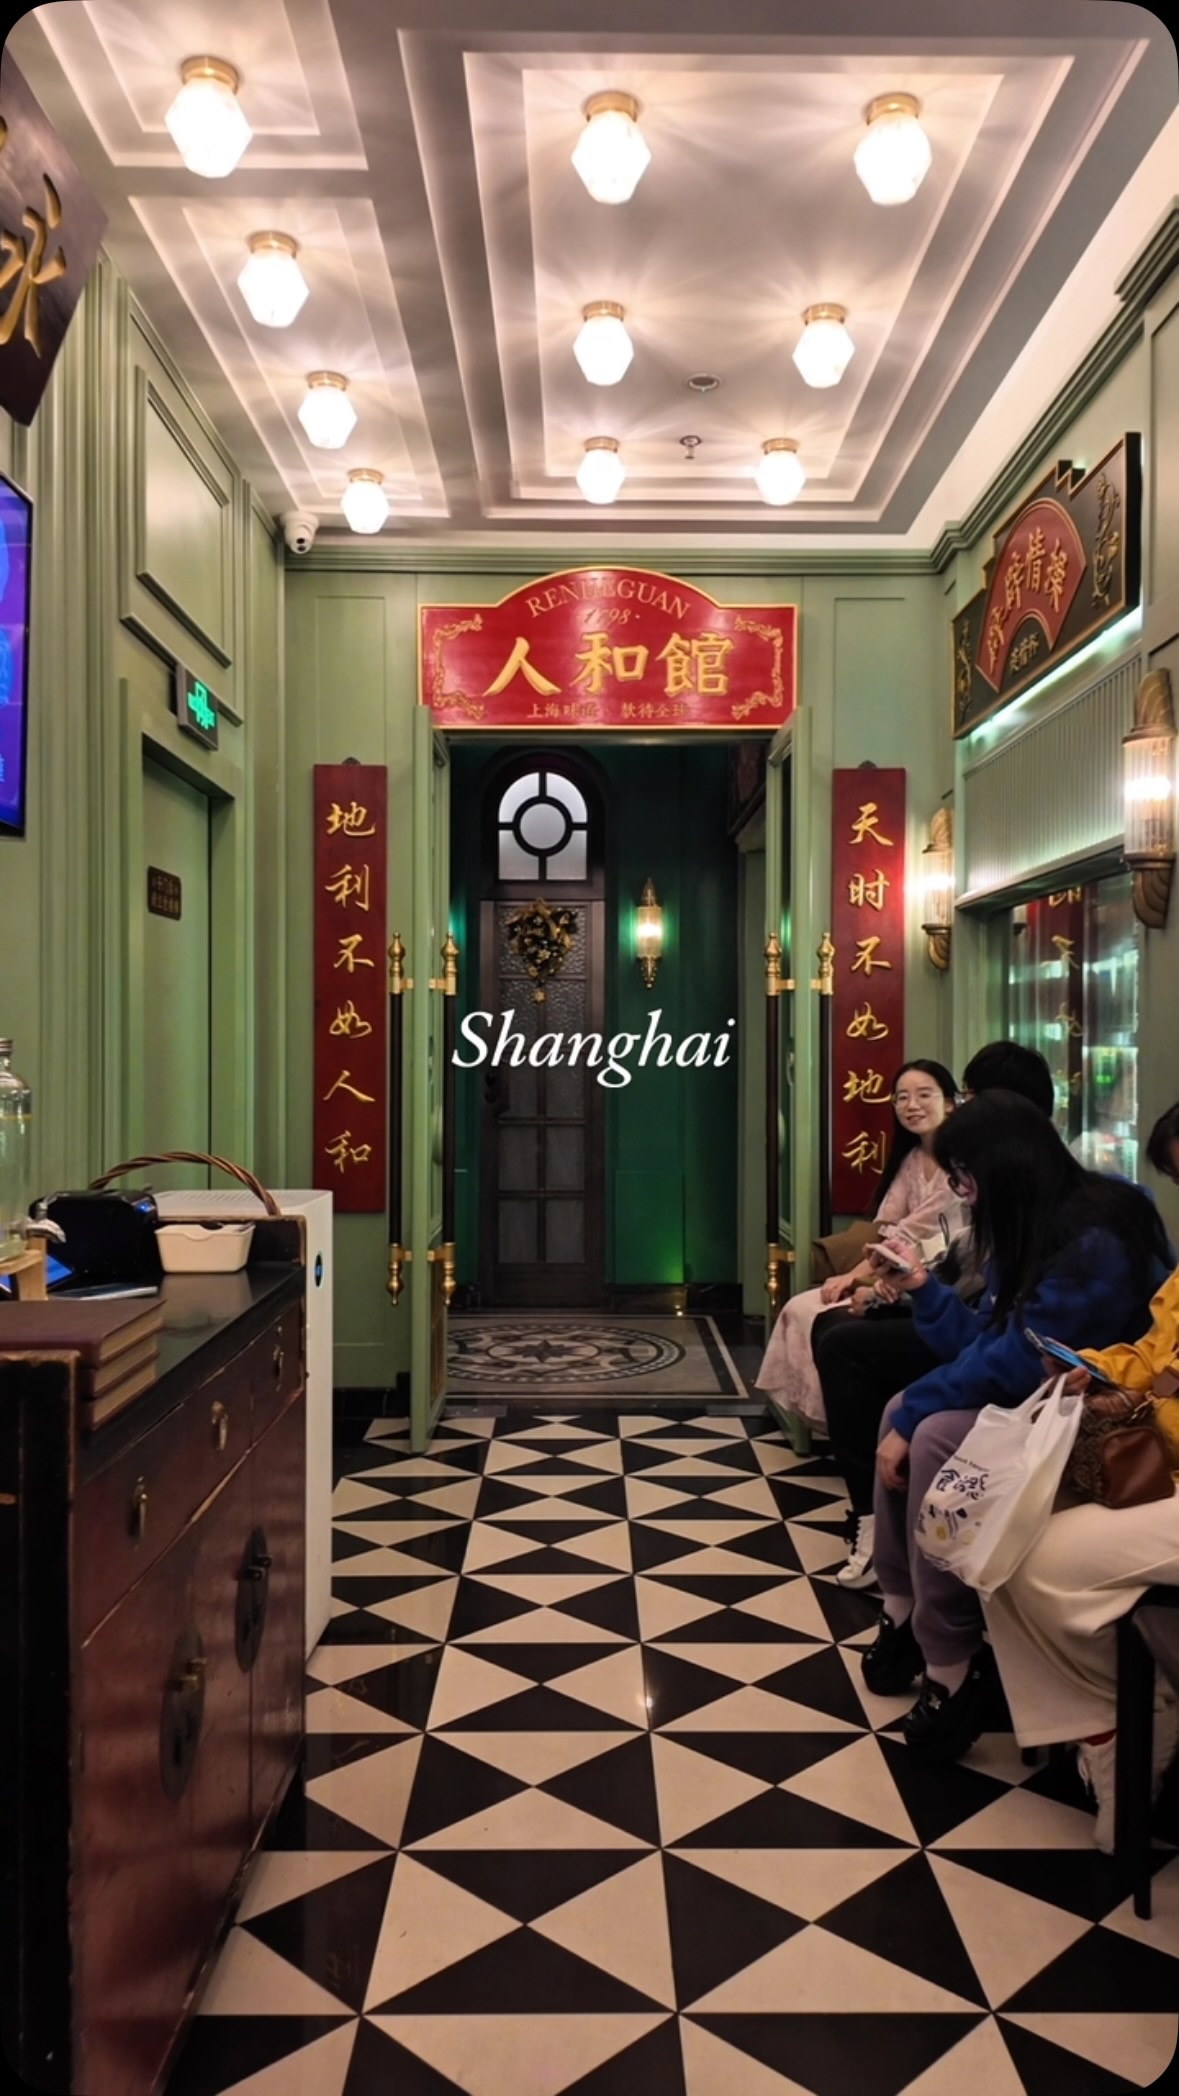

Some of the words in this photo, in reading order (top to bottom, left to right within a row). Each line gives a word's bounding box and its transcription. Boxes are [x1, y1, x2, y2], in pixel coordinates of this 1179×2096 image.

[482, 632, 736, 699] 人和館
[323, 801, 376, 1175] 地利不如人和
[841, 801, 895, 1175] 天时不如地利
